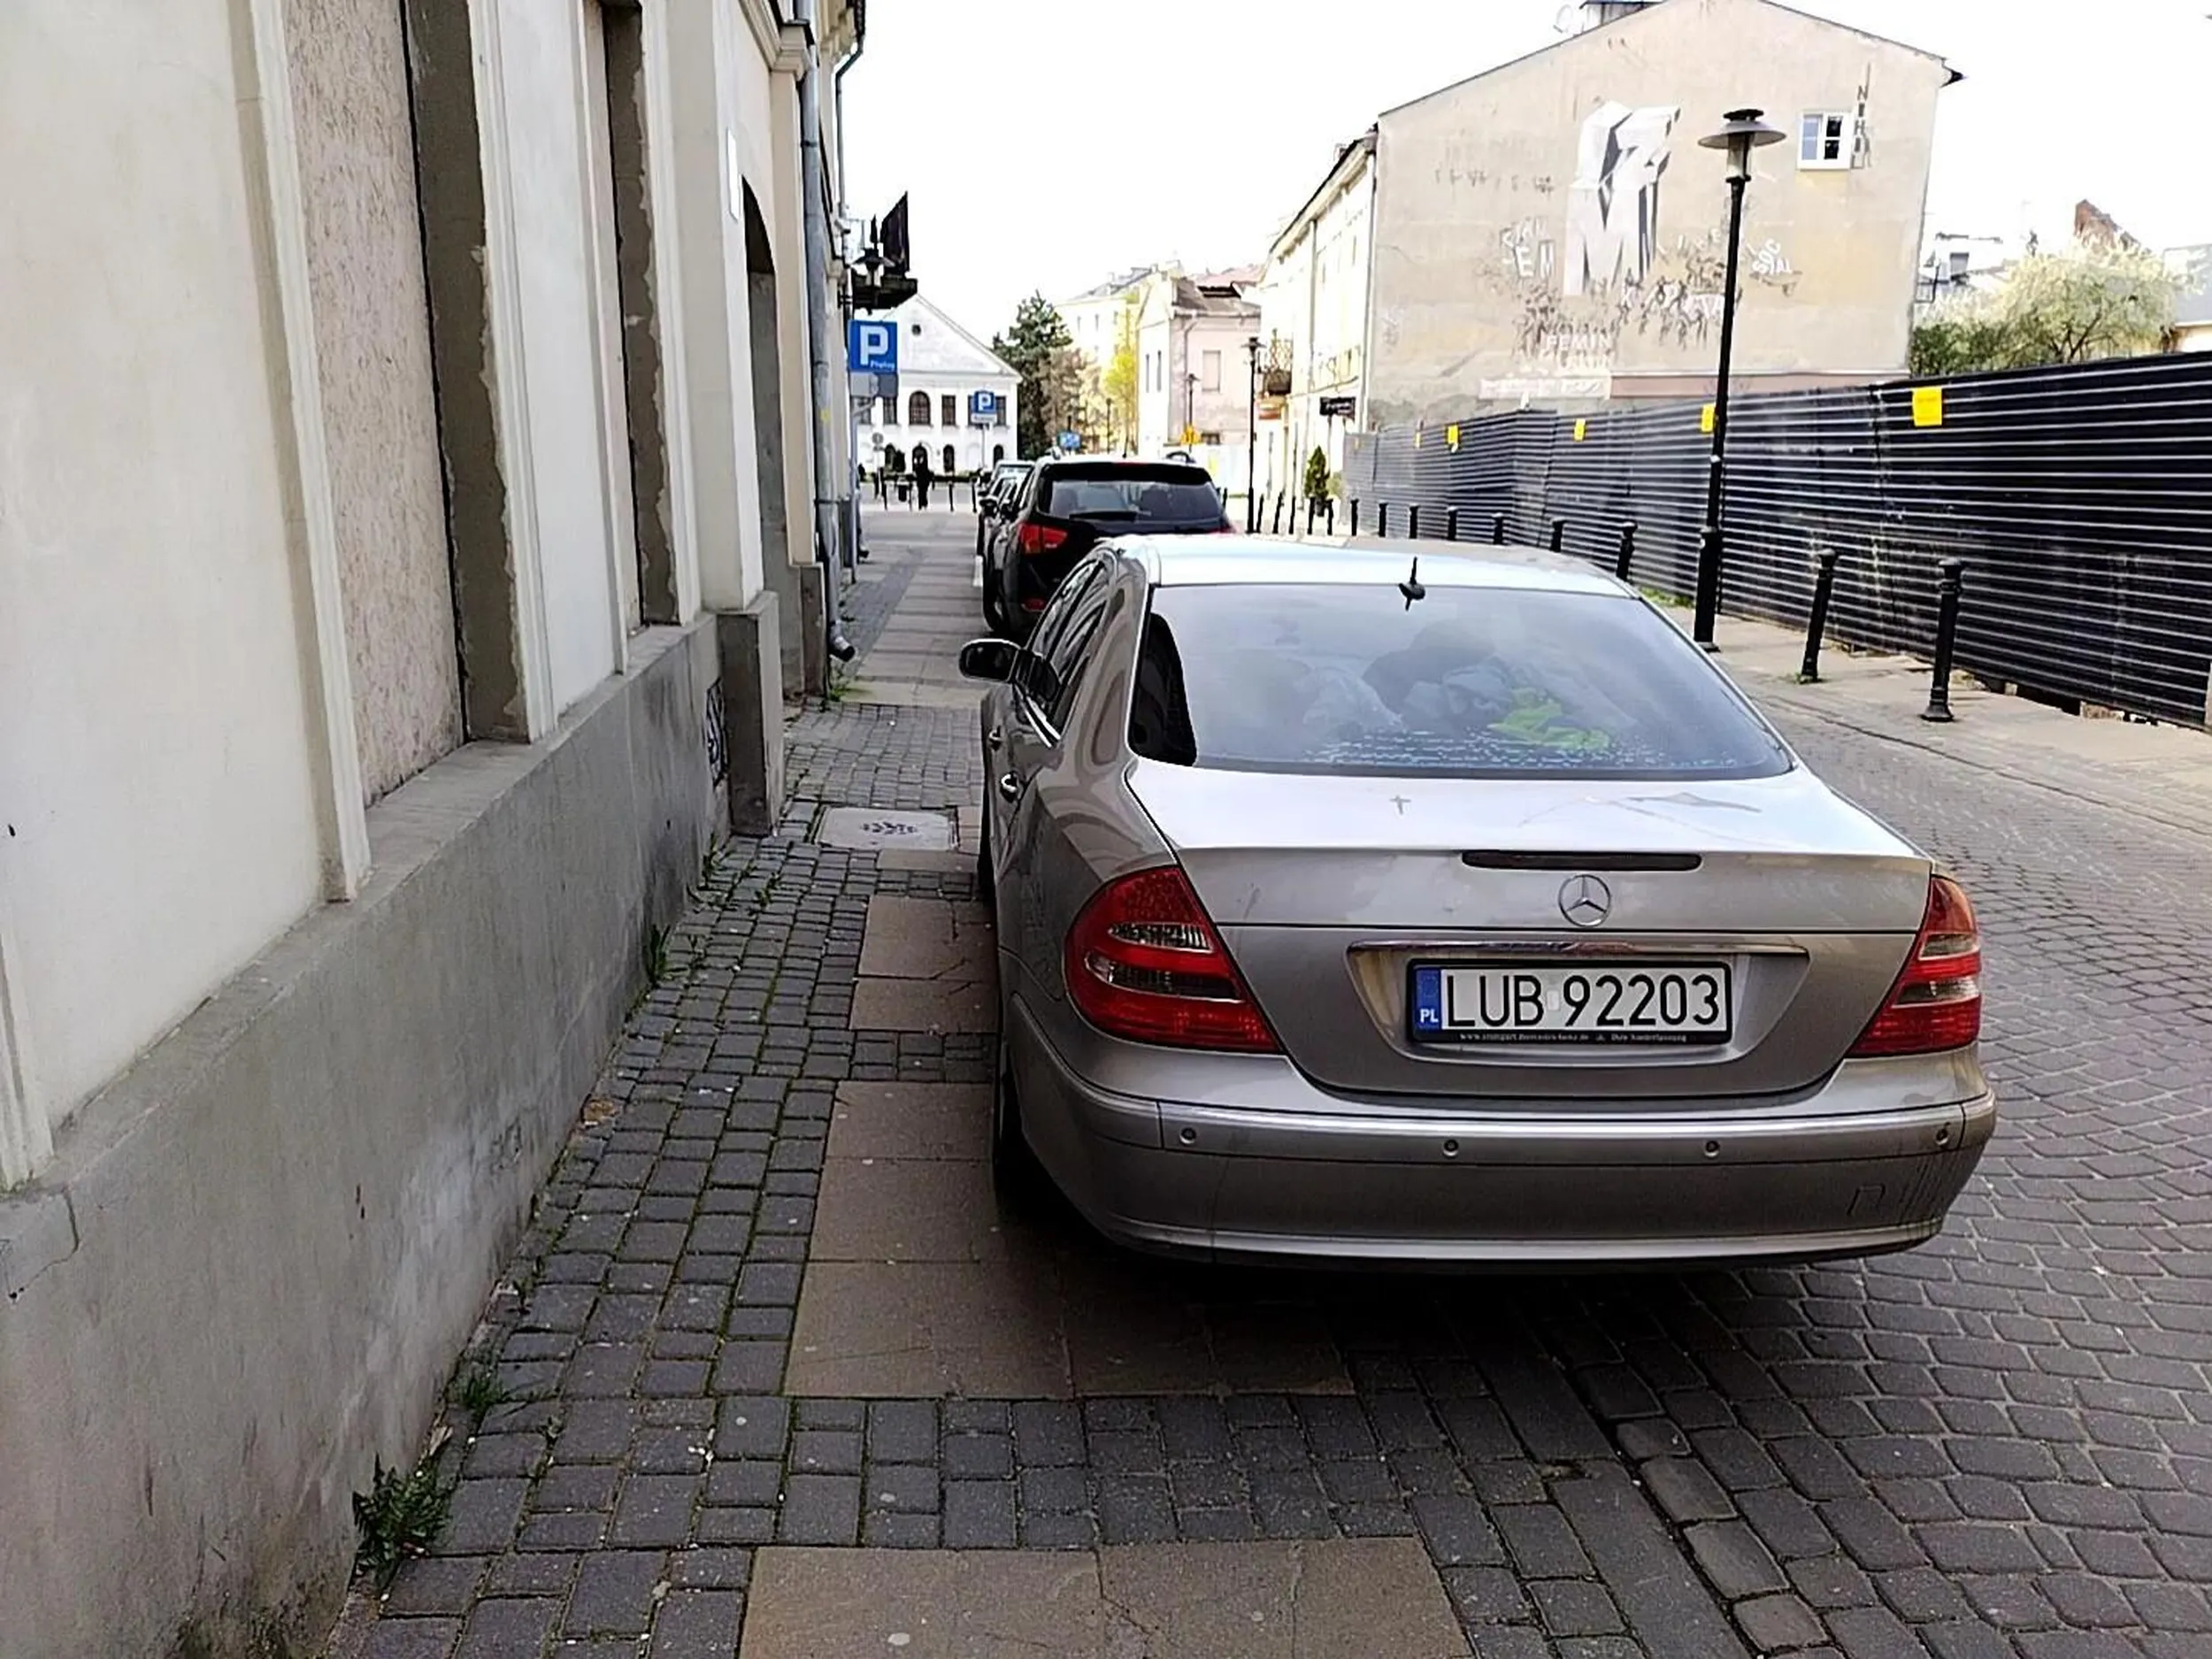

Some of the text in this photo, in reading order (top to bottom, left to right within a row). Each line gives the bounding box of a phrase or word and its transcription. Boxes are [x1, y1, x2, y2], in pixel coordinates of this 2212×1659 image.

[860, 326, 888, 365] P
[979, 394, 991, 411] P
[1447, 974, 1720, 1027] LUB 92203
[1419, 1009, 1439, 1023] PL
